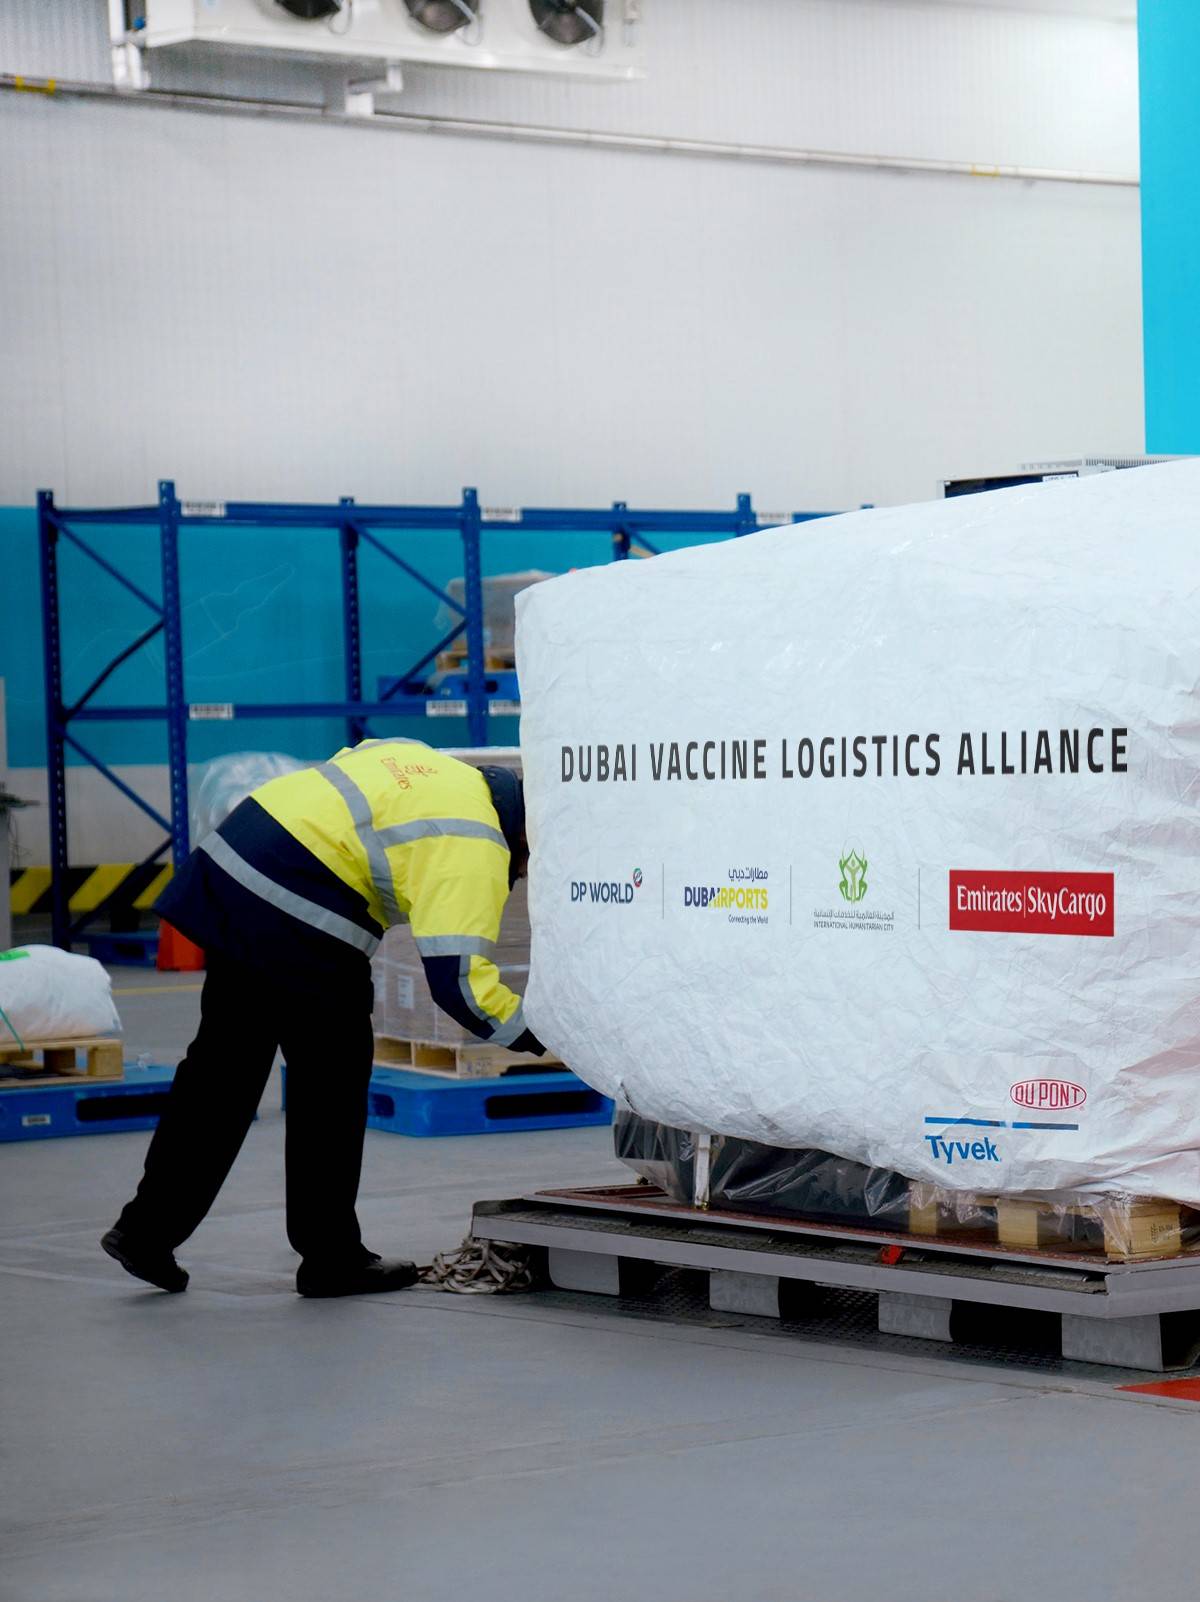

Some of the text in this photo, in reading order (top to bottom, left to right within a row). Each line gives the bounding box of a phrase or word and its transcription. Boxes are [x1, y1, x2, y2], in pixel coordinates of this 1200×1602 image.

[561, 727, 1129, 783] DUBAI VACCINE LOGISTICS ALLIANCE
[571, 881, 634, 904] DP WORLD
[956, 885, 1106, 921] Emirates SkyCargo
[813, 920, 895, 932] INTERNATIONAL HUMANITARIAN CITY
[924, 1134, 1000, 1165] Tyvek
